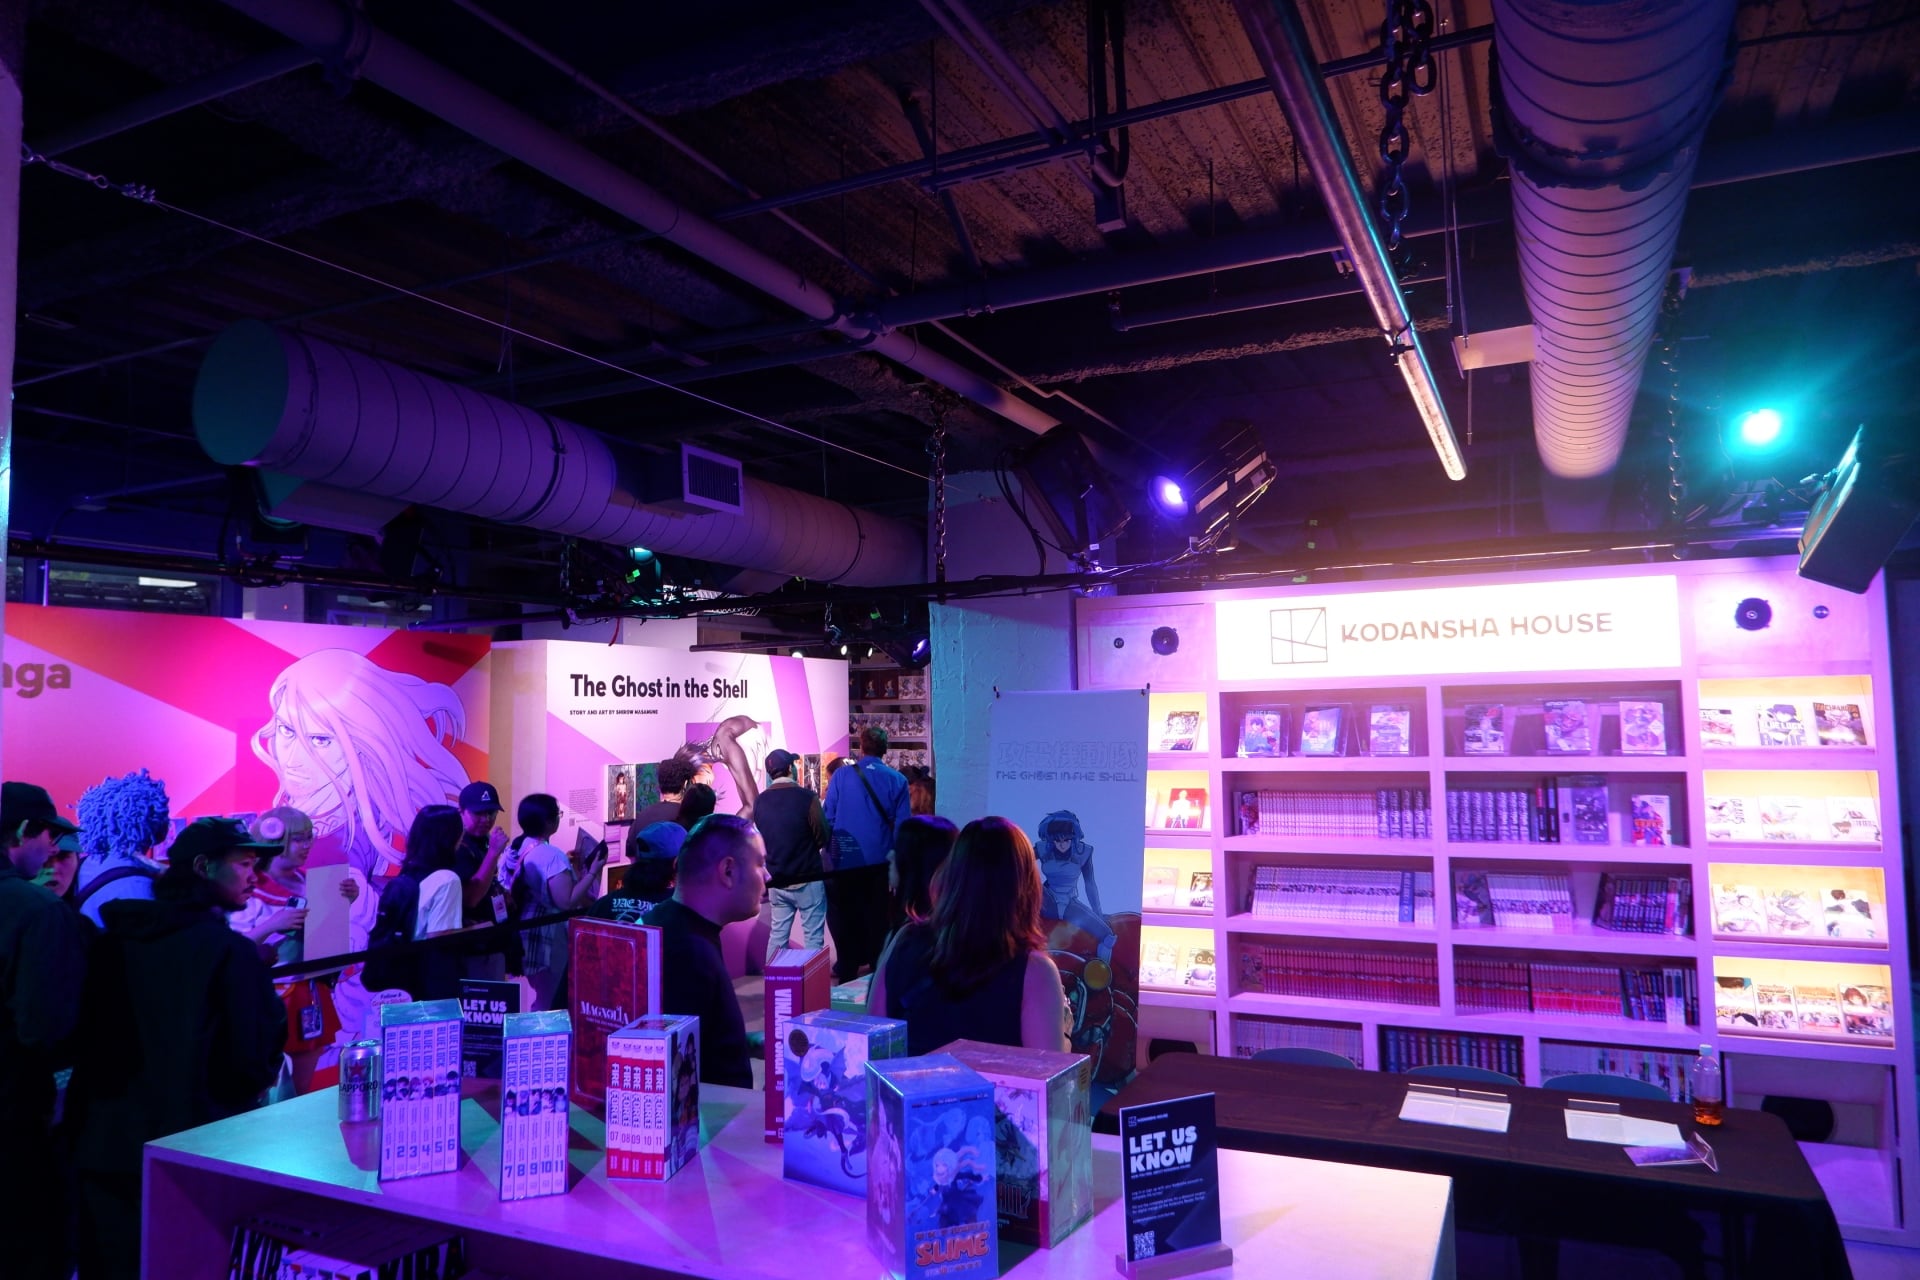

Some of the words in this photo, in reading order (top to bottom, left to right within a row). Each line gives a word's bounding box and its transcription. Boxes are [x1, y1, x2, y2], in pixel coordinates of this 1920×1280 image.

[1341, 618, 1499, 643] KODANSHA
[1511, 612, 1613, 635] HOUSE
[570, 674, 607, 697] The
[612, 675, 663, 698] Ghost
[666, 676, 681, 698] in
[684, 678, 709, 698] the
[713, 678, 748, 699] Shell
[996, 771, 1017, 780] THE
[1020, 771, 1057, 781] GHOST
[1098, 771, 1138, 782] SHELL
[463, 999, 487, 1011] LET
[490, 1001, 507, 1012] US
[464, 1011, 504, 1024] KNOW
[580, 1000, 629, 1025] MAGNOLIA
[633, 1066, 641, 1090] FIRE
[656, 1067, 664, 1091] FIRE
[611, 1090, 619, 1124] FORCE
[622, 1093, 630, 1127] FORCE
[632, 1094, 640, 1128] FORCE
[644, 1095, 652, 1129] FORCE
[655, 1095, 663, 1129] FORCE
[610, 1131, 618, 1140] 07
[622, 1133, 630, 1143] 08
[631, 1134, 640, 1144] 09
[644, 1135, 652, 1145] 10
[656, 1136, 662, 1145] 11
[1129, 1131, 1166, 1153] LET
[1171, 1126, 1198, 1146] US
[422, 1144, 430, 1156] 4
[435, 1141, 442, 1153] 5
[447, 1138, 455, 1150] 6
[386, 1149, 390, 1160] 1
[397, 1146, 405, 1158] 2
[409, 1145, 417, 1158] 3
[555, 1160, 564, 1172] 11
[1130, 1145, 1194, 1174] KNOW
[505, 1165, 512, 1177] 7
[517, 1163, 525, 1176] 8
[530, 1162, 537, 1175] 9
[541, 1161, 552, 1173] 10
[916, 1231, 989, 1267] SLIME
